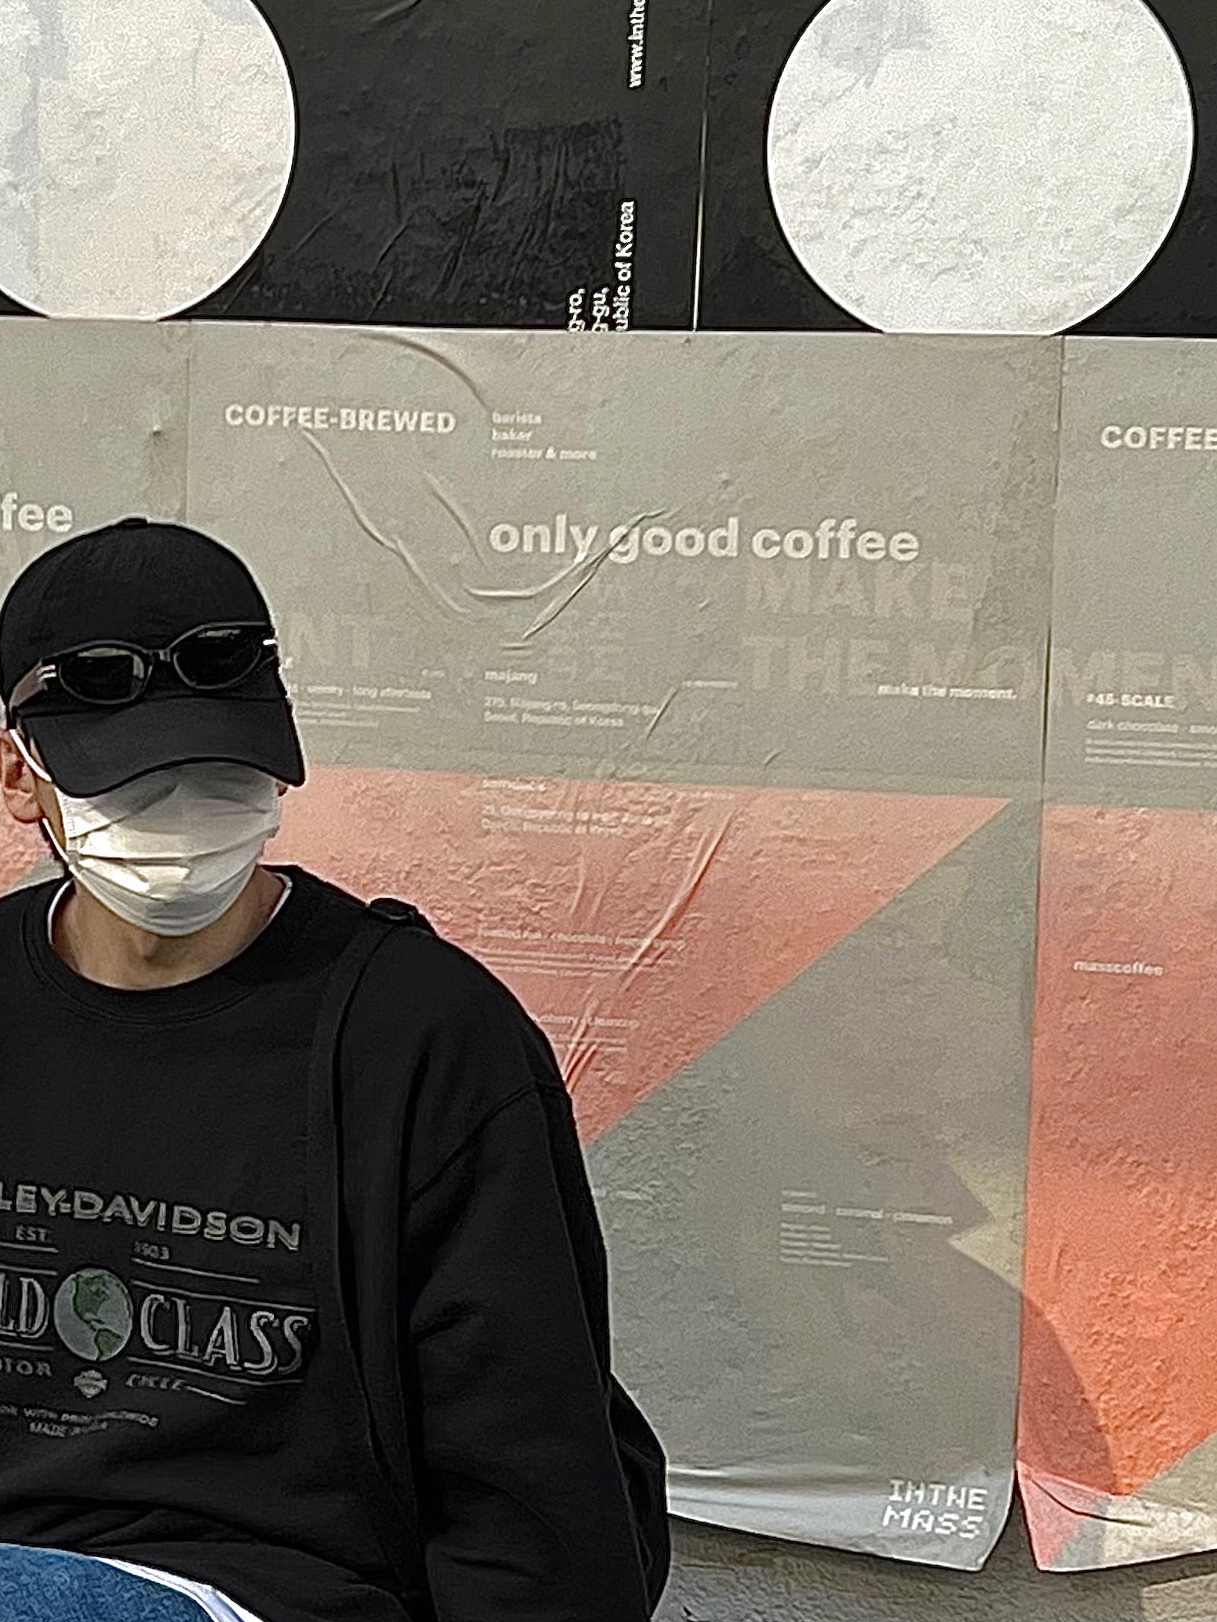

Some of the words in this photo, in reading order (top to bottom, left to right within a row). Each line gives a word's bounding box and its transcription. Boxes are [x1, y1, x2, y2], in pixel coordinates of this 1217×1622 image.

[615, 201, 635, 258] Korea
[614, 261, 632, 282] of
[224, 404, 458, 433] COFFEE-BREWED
[545, 446, 557, 460] &
[559, 448, 598, 461] more
[489, 514, 598, 565] only
[609, 516, 739, 564] good
[751, 518, 920, 562] coffee
[484, 670, 538, 685] majang
[15, 1225, 50, 1243] EST
[140, 1293, 313, 1376] CLASS
[881, 1505, 983, 1539] MASS
